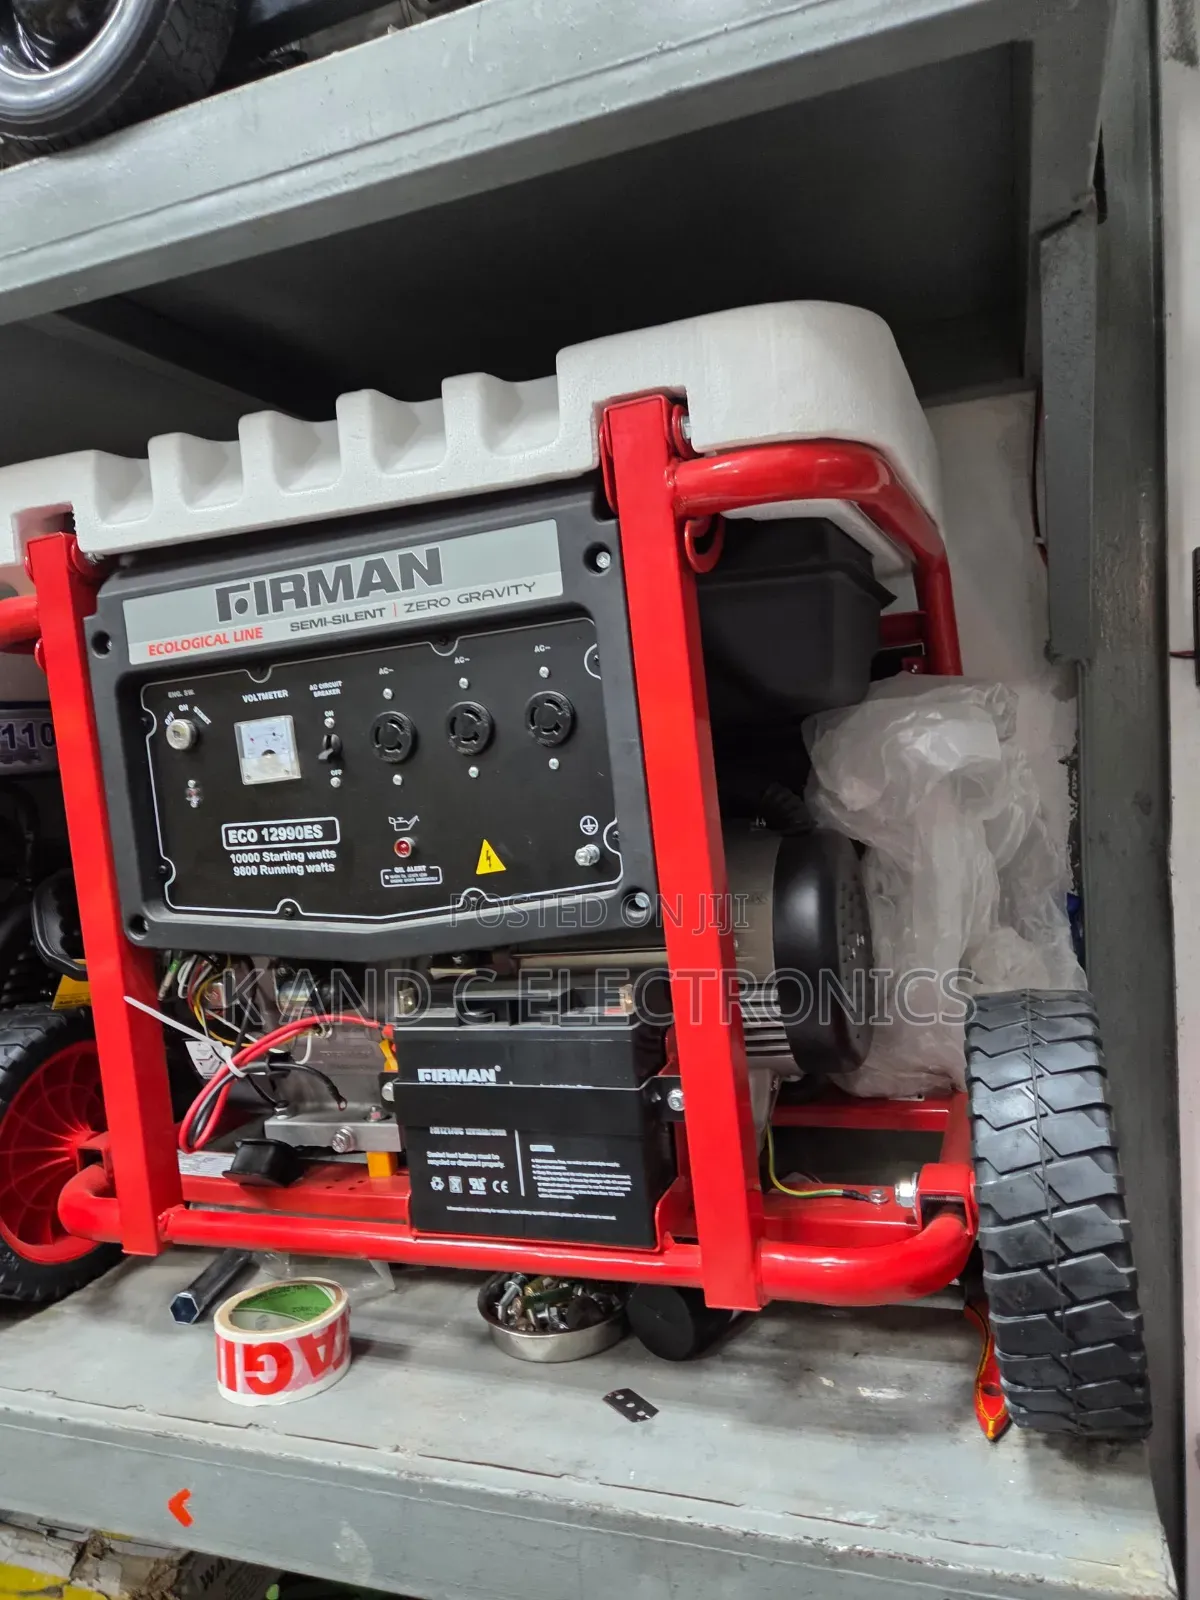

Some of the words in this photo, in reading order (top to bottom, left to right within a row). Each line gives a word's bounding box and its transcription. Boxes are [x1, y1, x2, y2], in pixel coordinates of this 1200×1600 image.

[215, 547, 443, 622] FIRMAN
[404, 597, 450, 613] ZERO
[457, 581, 536, 604] GRAVITY
[290, 607, 386, 632] SEMI-SILENT
[148, 629, 230, 656] ECOLOGICAL
[233, 627, 263, 643] LINE
[318, 680, 343, 689] CIRCUIT
[242, 689, 289, 703] VOLTMETER
[313, 688, 341, 698] BREAKER
[178, 704, 189, 712] ON
[227, 828, 257, 844] ECO
[261, 824, 323, 842] 12990ES
[230, 852, 260, 864] 10000
[262, 850, 305, 864] Starting
[306, 849, 337, 860] watts
[233, 865, 258, 876] 9800
[260, 863, 304, 876] Running
[306, 862, 335, 873] watts
[406, 865, 427, 873] ALERT
